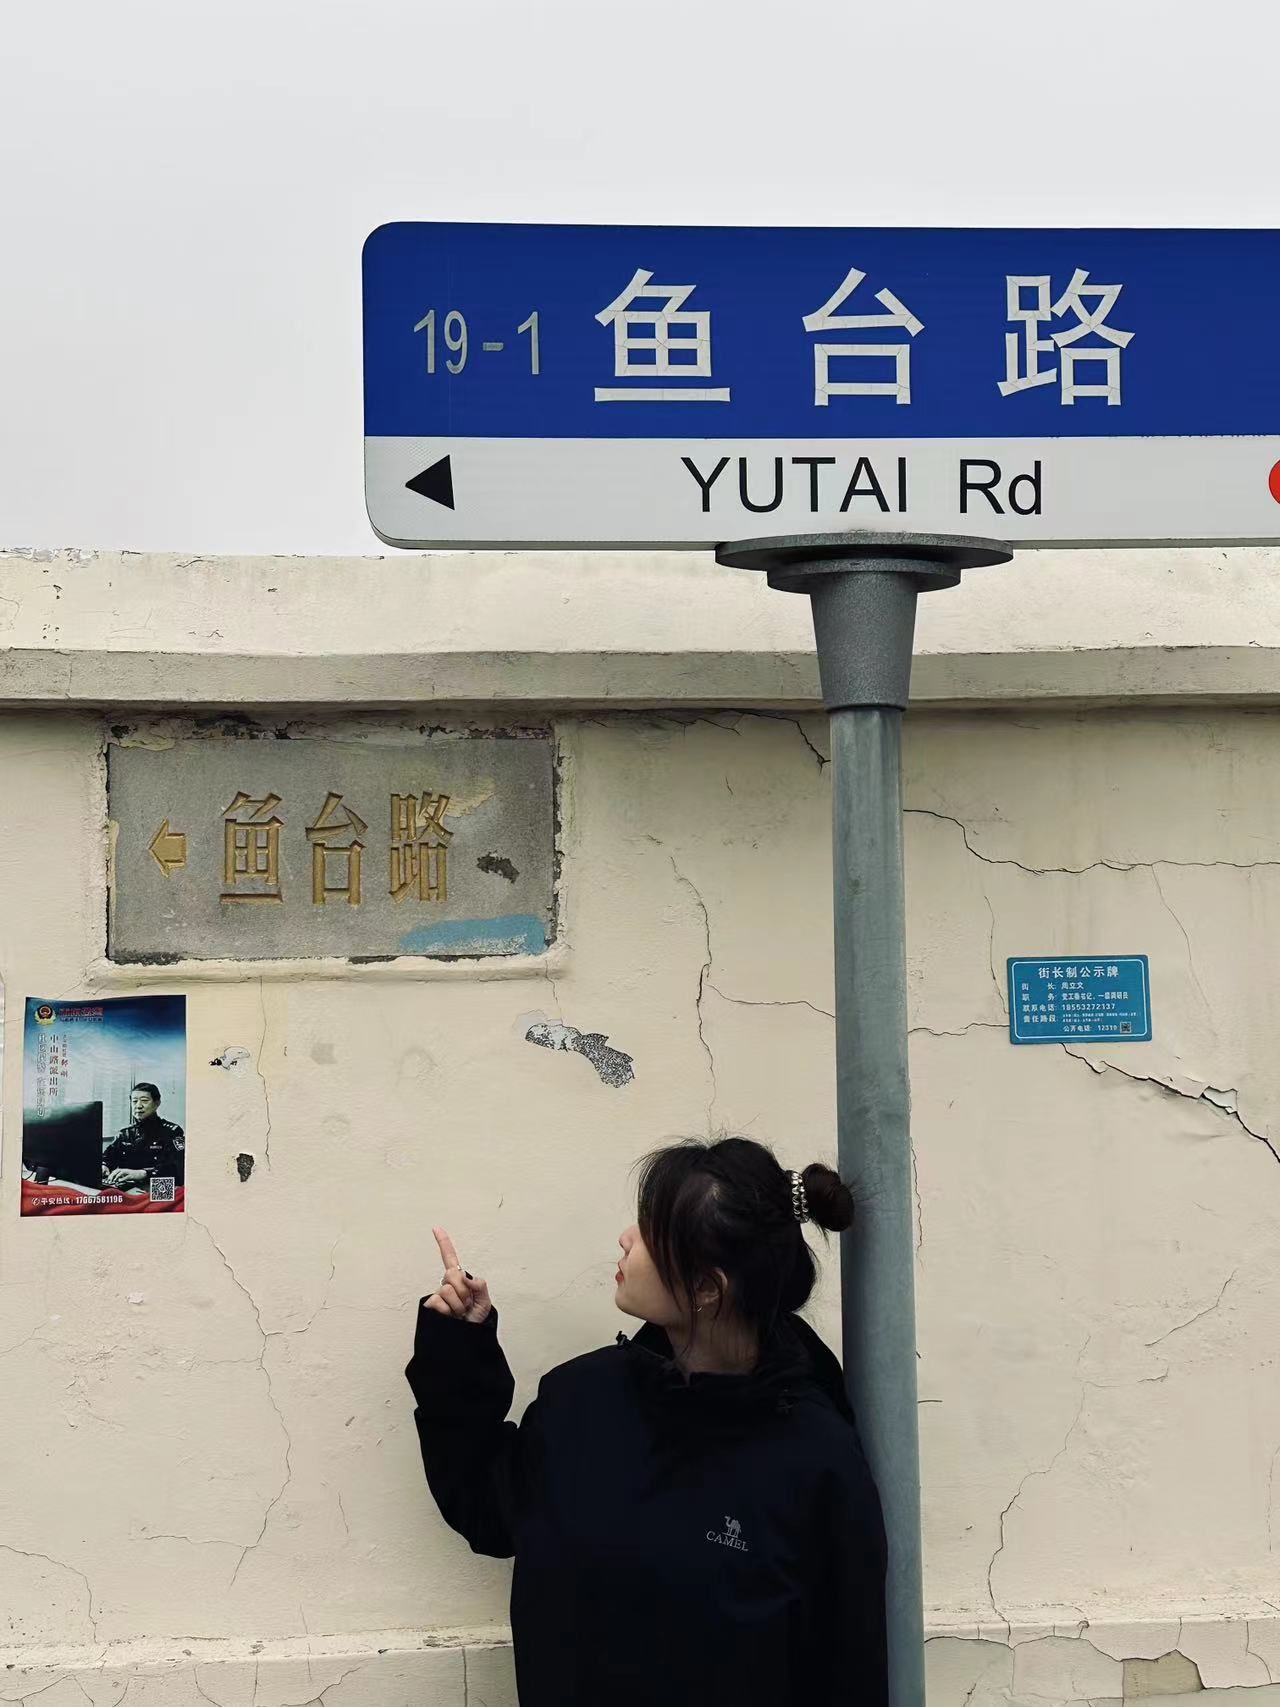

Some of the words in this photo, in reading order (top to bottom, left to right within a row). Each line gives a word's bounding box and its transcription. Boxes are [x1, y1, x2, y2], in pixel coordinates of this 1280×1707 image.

[594, 267, 1136, 407] 鱼台路
[682, 456, 908, 512] YUTAI
[959, 460, 1043, 515] Rd
[219, 791, 454, 905] 鱼台路
[1038, 966, 1119, 979] 街长制公示牌
[1062, 1003, 1115, 1011] 18553272137
[48, 1033, 59, 1097] 中山路派出所
[706, 1530, 749, 1552] CAMEL
